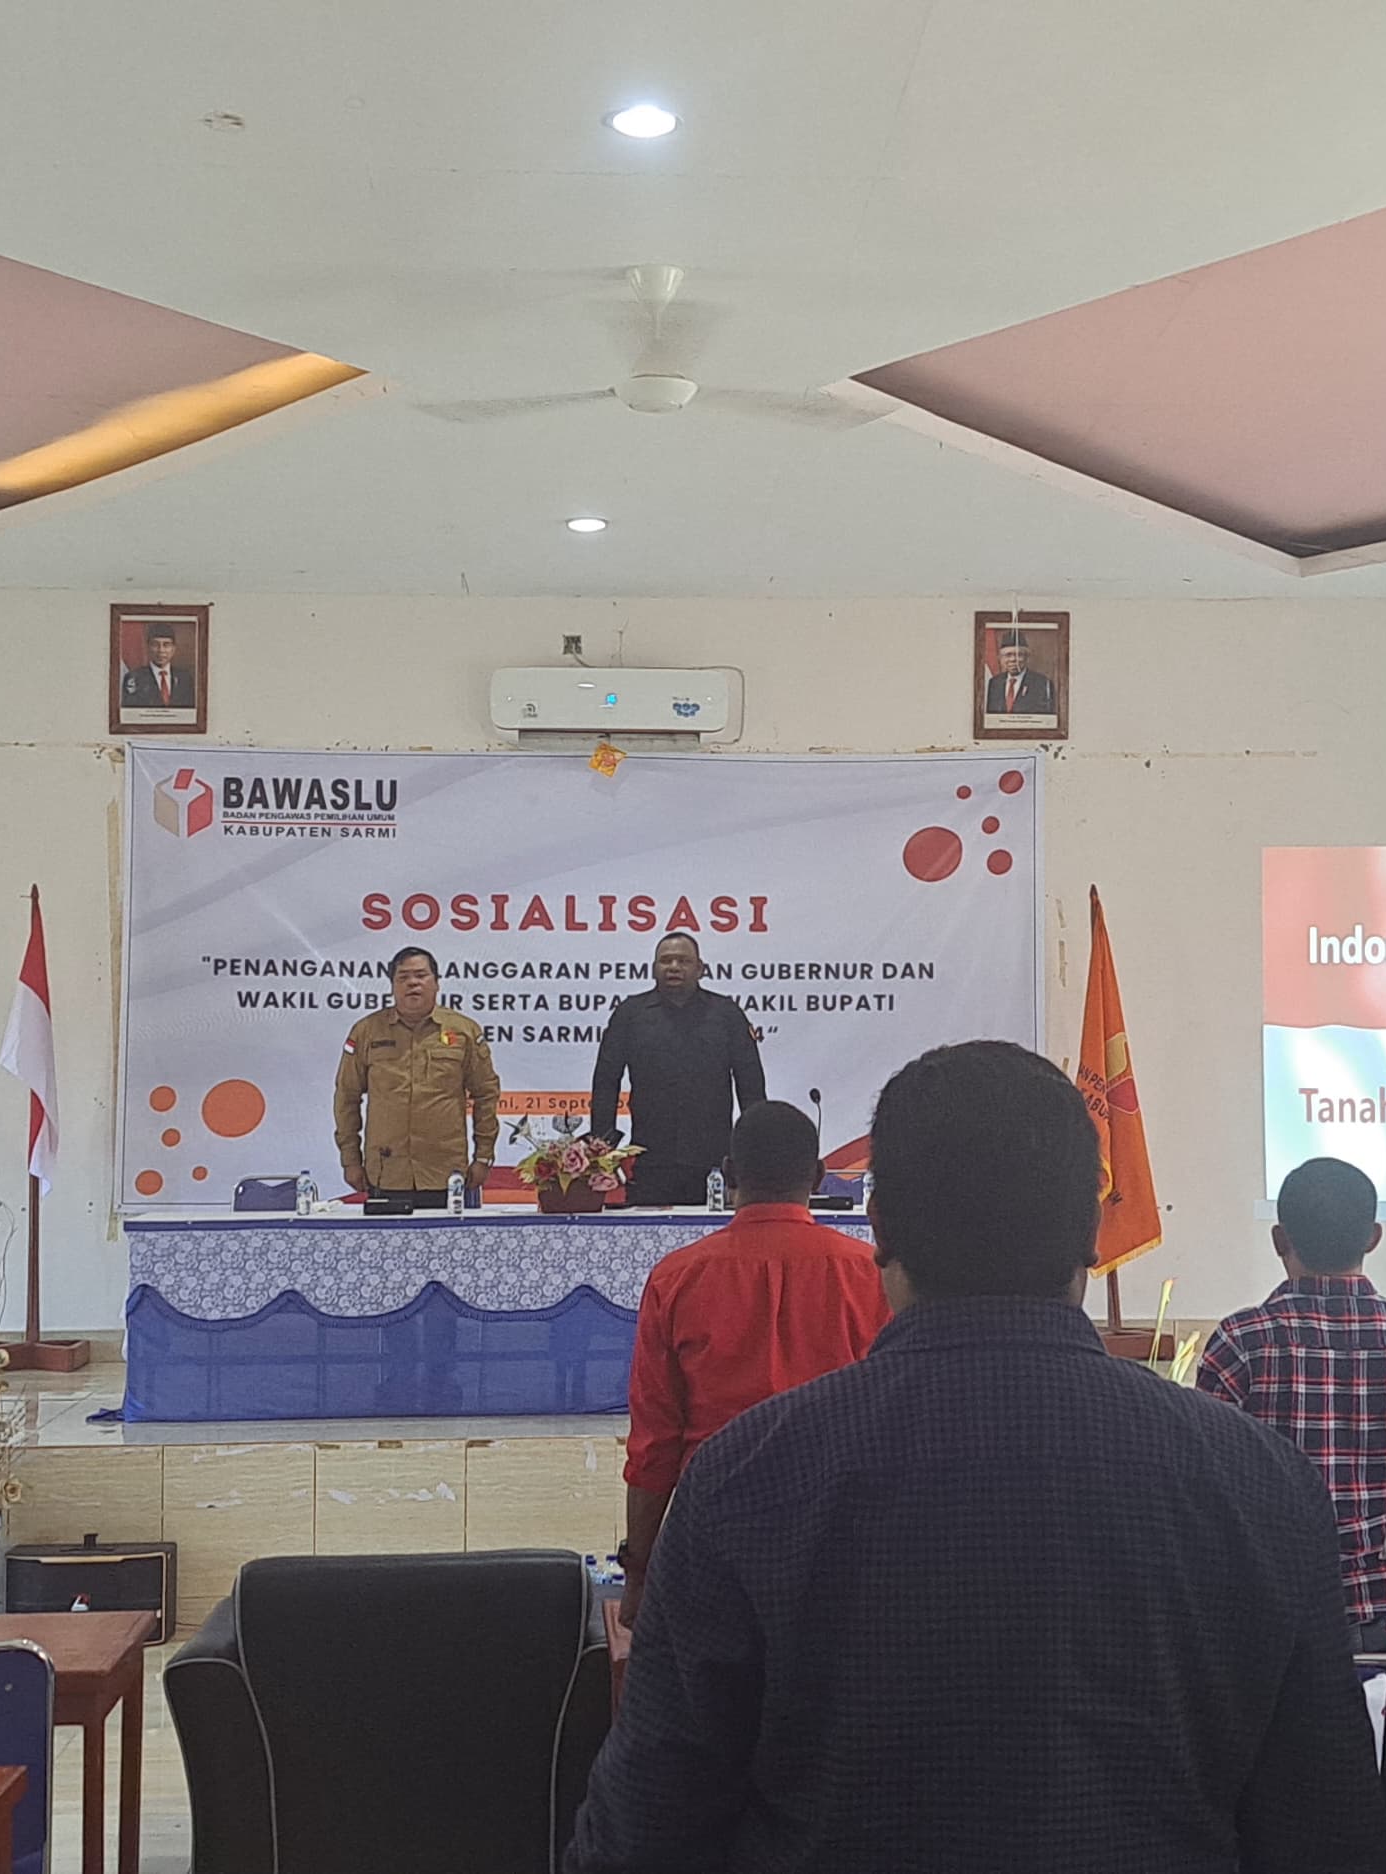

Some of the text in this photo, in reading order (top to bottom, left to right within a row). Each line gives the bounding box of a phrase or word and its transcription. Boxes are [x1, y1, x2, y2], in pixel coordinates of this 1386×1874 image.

[223, 777, 397, 811] BAWASLU
[222, 811, 257, 819] BADAN
[259, 812, 311, 820] PENGAWAS
[314, 813, 363, 821] PEMILIHAN
[223, 825, 396, 838] KABUPATEN SARMI
[362, 893, 768, 933] SOSIALISASI
[438, 962, 590, 980] ANGGARAN
[741, 963, 873, 980] GUBERNUR
[882, 963, 934, 980] DAN
[237, 991, 319, 1009] WAKIL
[472, 994, 550, 1012] SERTA
[806, 994, 895, 1012] BUPATI
[523, 1025, 601, 1043] SARMI
[526, 1097, 541, 1109] 21
